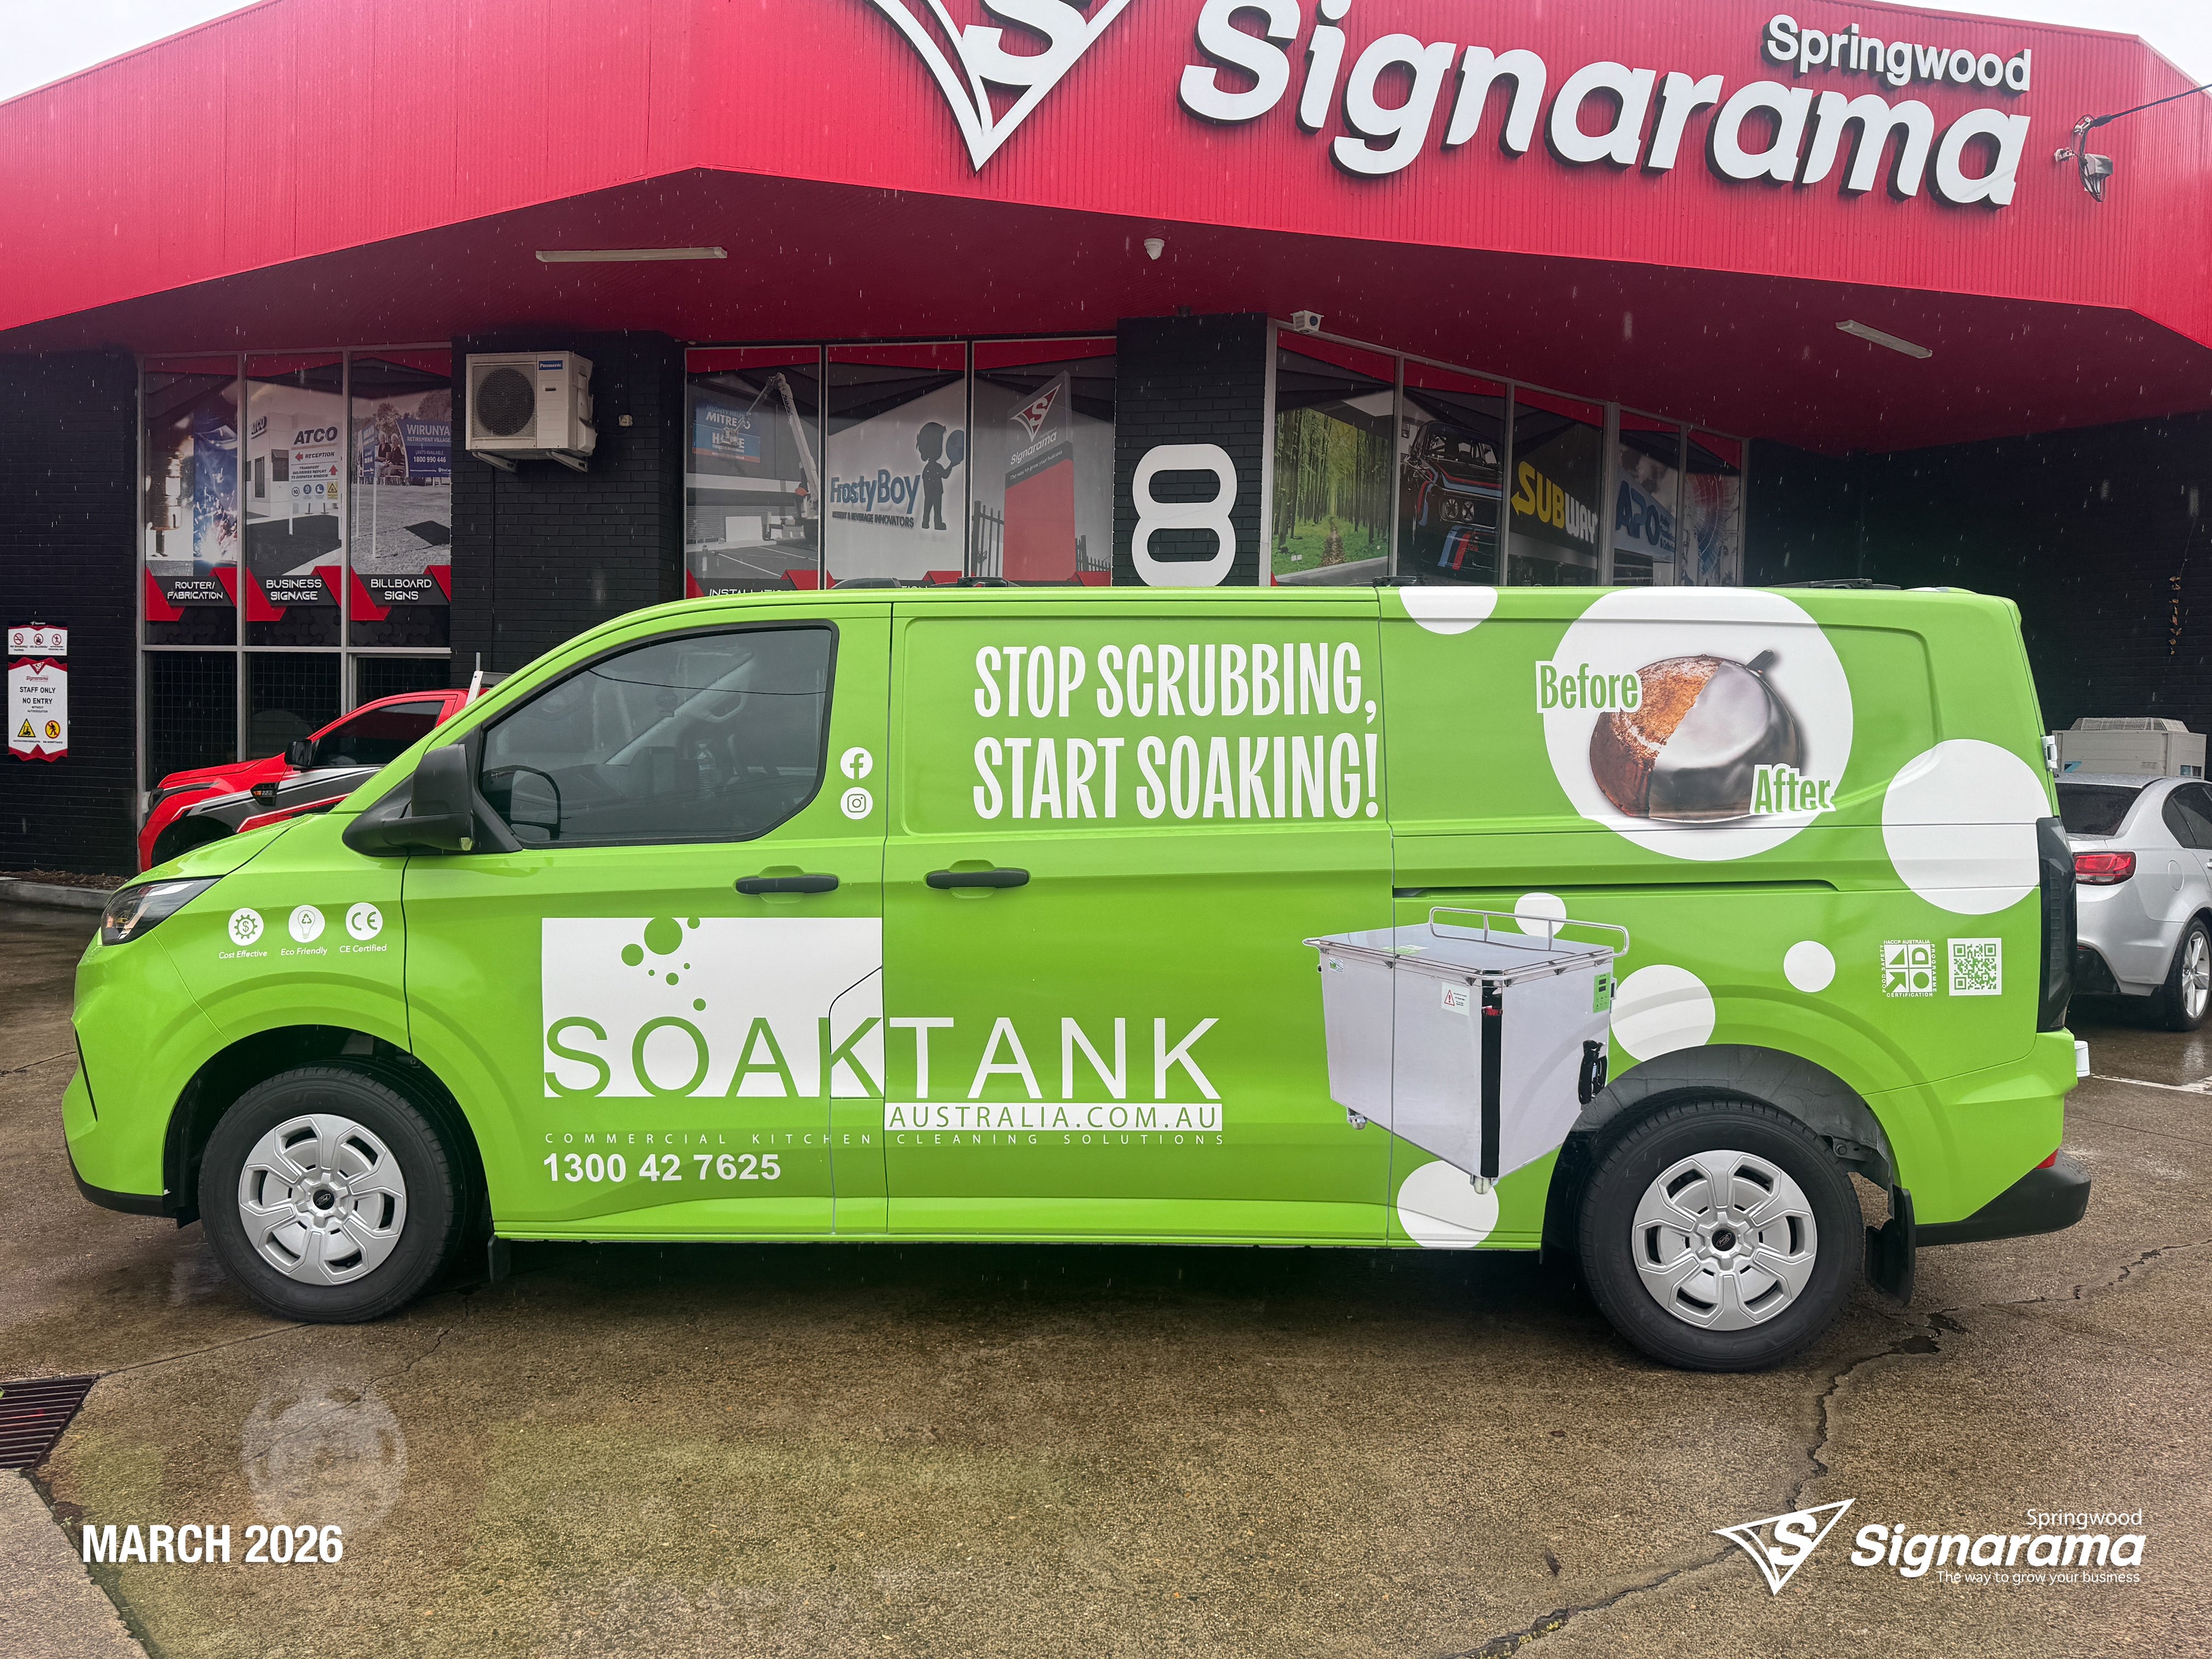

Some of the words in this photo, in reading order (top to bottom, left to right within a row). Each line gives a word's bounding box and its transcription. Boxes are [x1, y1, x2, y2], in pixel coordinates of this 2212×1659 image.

[1767, 14, 2032, 91] Springwood
[1180, 0, 2031, 208] Signarama
[706, 411, 737, 426] MITRE
[294, 426, 338, 445] ATCO
[407, 424, 451, 436] WIRUNYA
[712, 432, 745, 449] HE
[1010, 431, 1058, 466] Signarama
[1510, 461, 1598, 544] SUBWAY
[874, 514, 914, 528] INNOVATORS
[1132, 443, 1238, 586] 8
[174, 581, 216, 590] ROUTER/
[266, 579, 322, 589] BUSINESS
[370, 578, 432, 589] BILLBOARD
[167, 591, 224, 600] FABRICATION
[270, 590, 319, 601] SIGNAGE
[384, 590, 419, 601] SIGNS
[973, 645, 1086, 718] STOP
[1096, 642, 1377, 725] SCRUBBING,
[1539, 662, 1639, 709] Before
[973, 736, 1125, 819] START
[1136, 732, 1379, 819] SOAKING!
[1754, 767, 1831, 814] After
[218, 951, 235, 960] Cost
[236, 950, 268, 958] Effective
[296, 946, 328, 956] Friendly
[352, 944, 387, 953] Certified
[889, 1106, 1216, 1128] AUSTRALIA.COM.AU
[545, 1133, 725, 1144] COMMERCIAL
[753, 1133, 870, 1144] KITCHEN
[896, 1134, 1037, 1145] CLEANING
[1063, 1134, 1223, 1145] SOLUTIONS
[544, 1153, 626, 1182] 1300
[639, 1153, 682, 1181] 42
[693, 1153, 781, 1180] 7625
